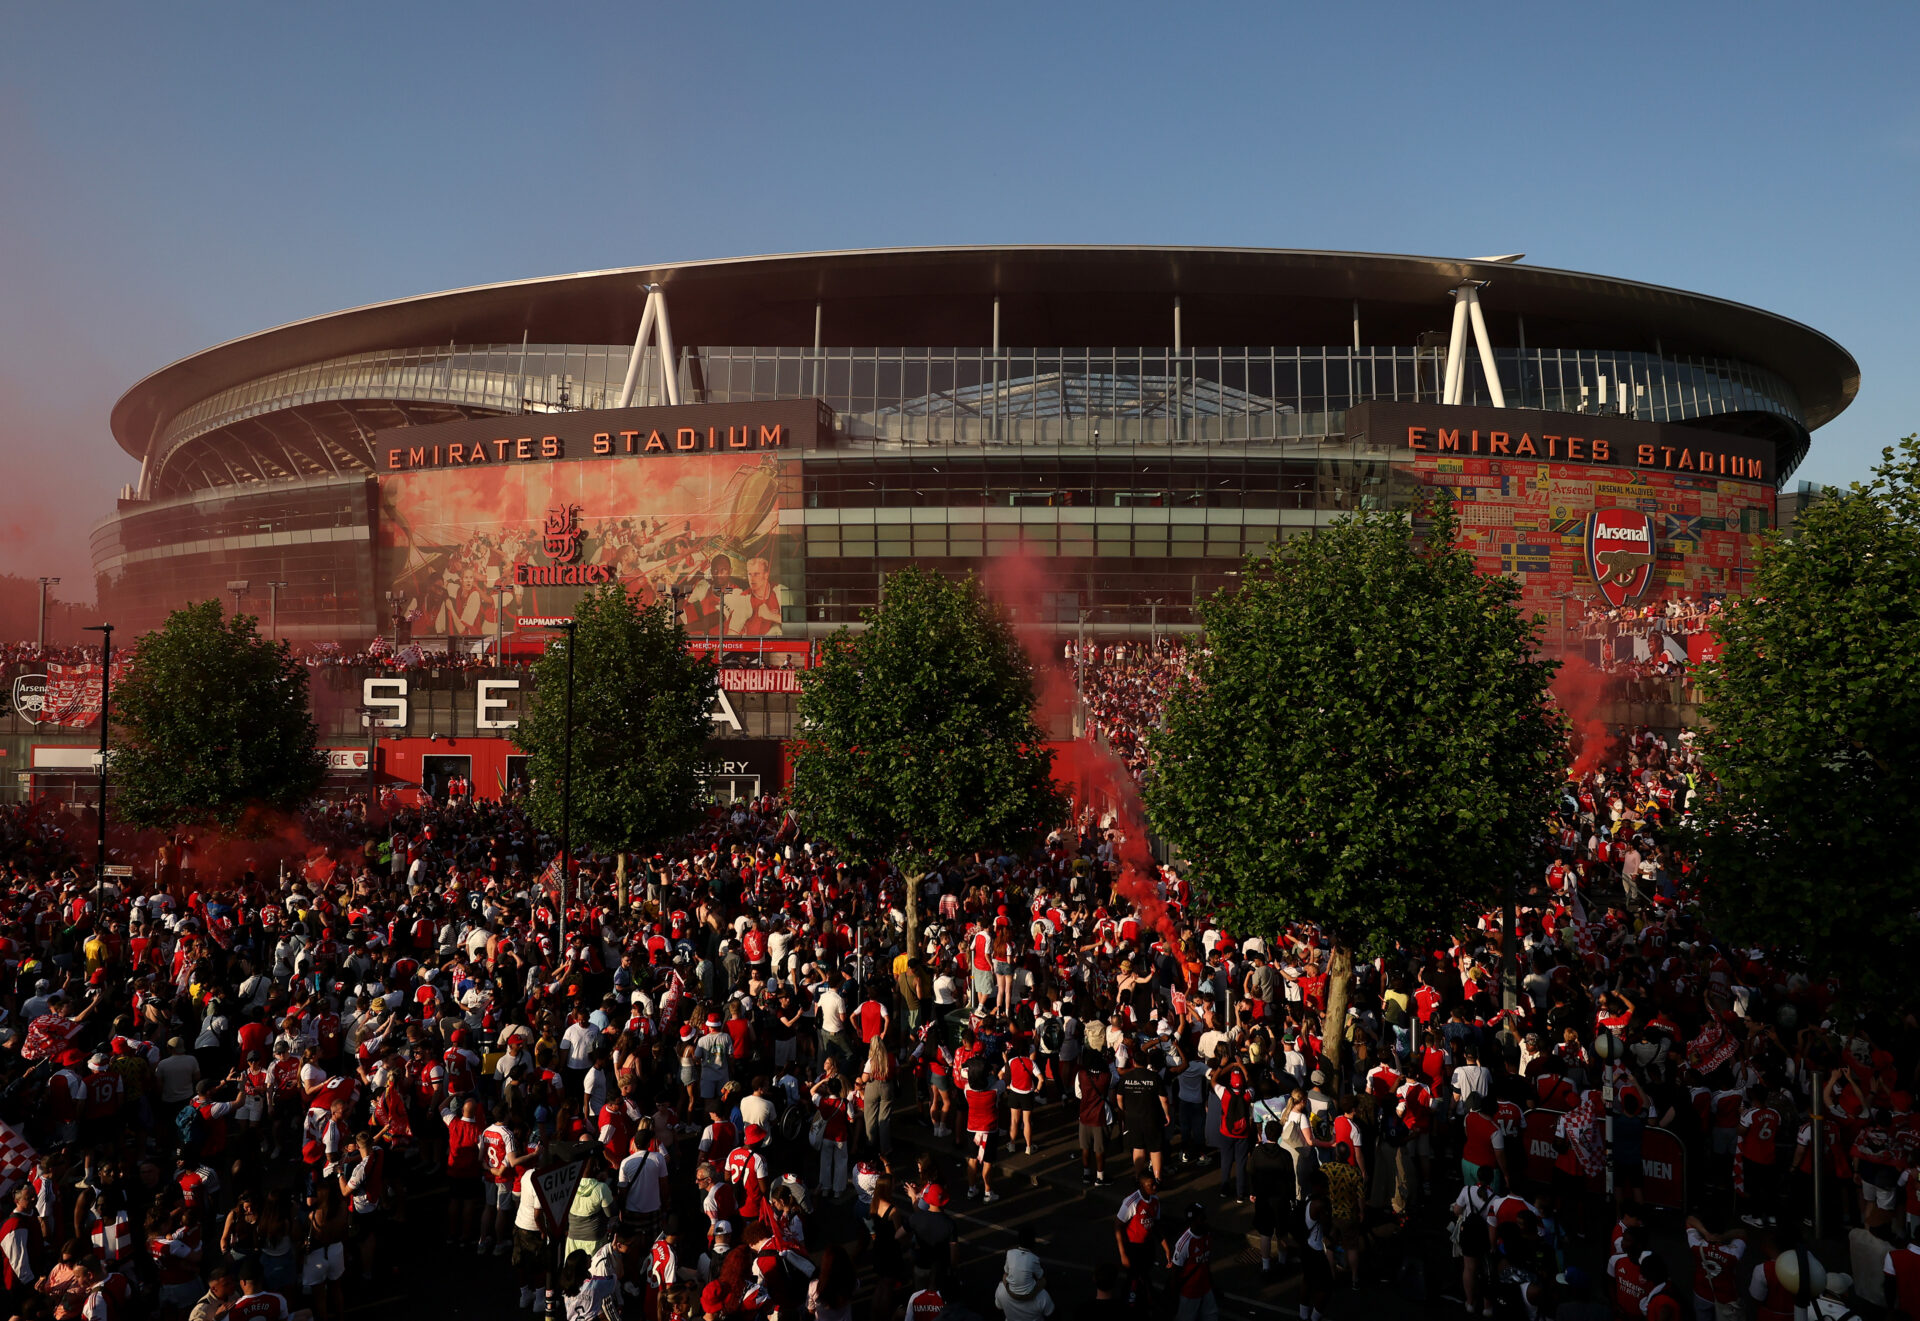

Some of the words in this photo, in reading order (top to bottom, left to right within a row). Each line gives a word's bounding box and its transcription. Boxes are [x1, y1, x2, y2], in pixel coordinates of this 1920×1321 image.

[389, 436, 559, 469] EMIRATES
[593, 424, 782, 455] STADIUM
[1408, 427, 1609, 461] EMIRATES
[1638, 444, 1763, 480] STADIUM
[1432, 474, 1455, 485] ARSENAL
[1552, 481, 1594, 497] Arsenal
[1597, 484, 1624, 494] ARSENAL
[1625, 487, 1654, 497] MALDIVES
[1596, 523, 1648, 542] Arsenal
[514, 561, 610, 585] Emirates
[1656, 569, 1682, 577] ERMANY
[518, 618, 561, 626] CHAPMAN'S
[1650, 935, 1663, 948] 10
[91, 1082, 113, 1104] 19
[1497, 1119, 1519, 1138] 14
[1758, 1121, 1773, 1140] 6
[487, 1146, 499, 1168] 8
[544, 1165, 577, 1191] GIVE
[551, 1187, 571, 1203] WAY
